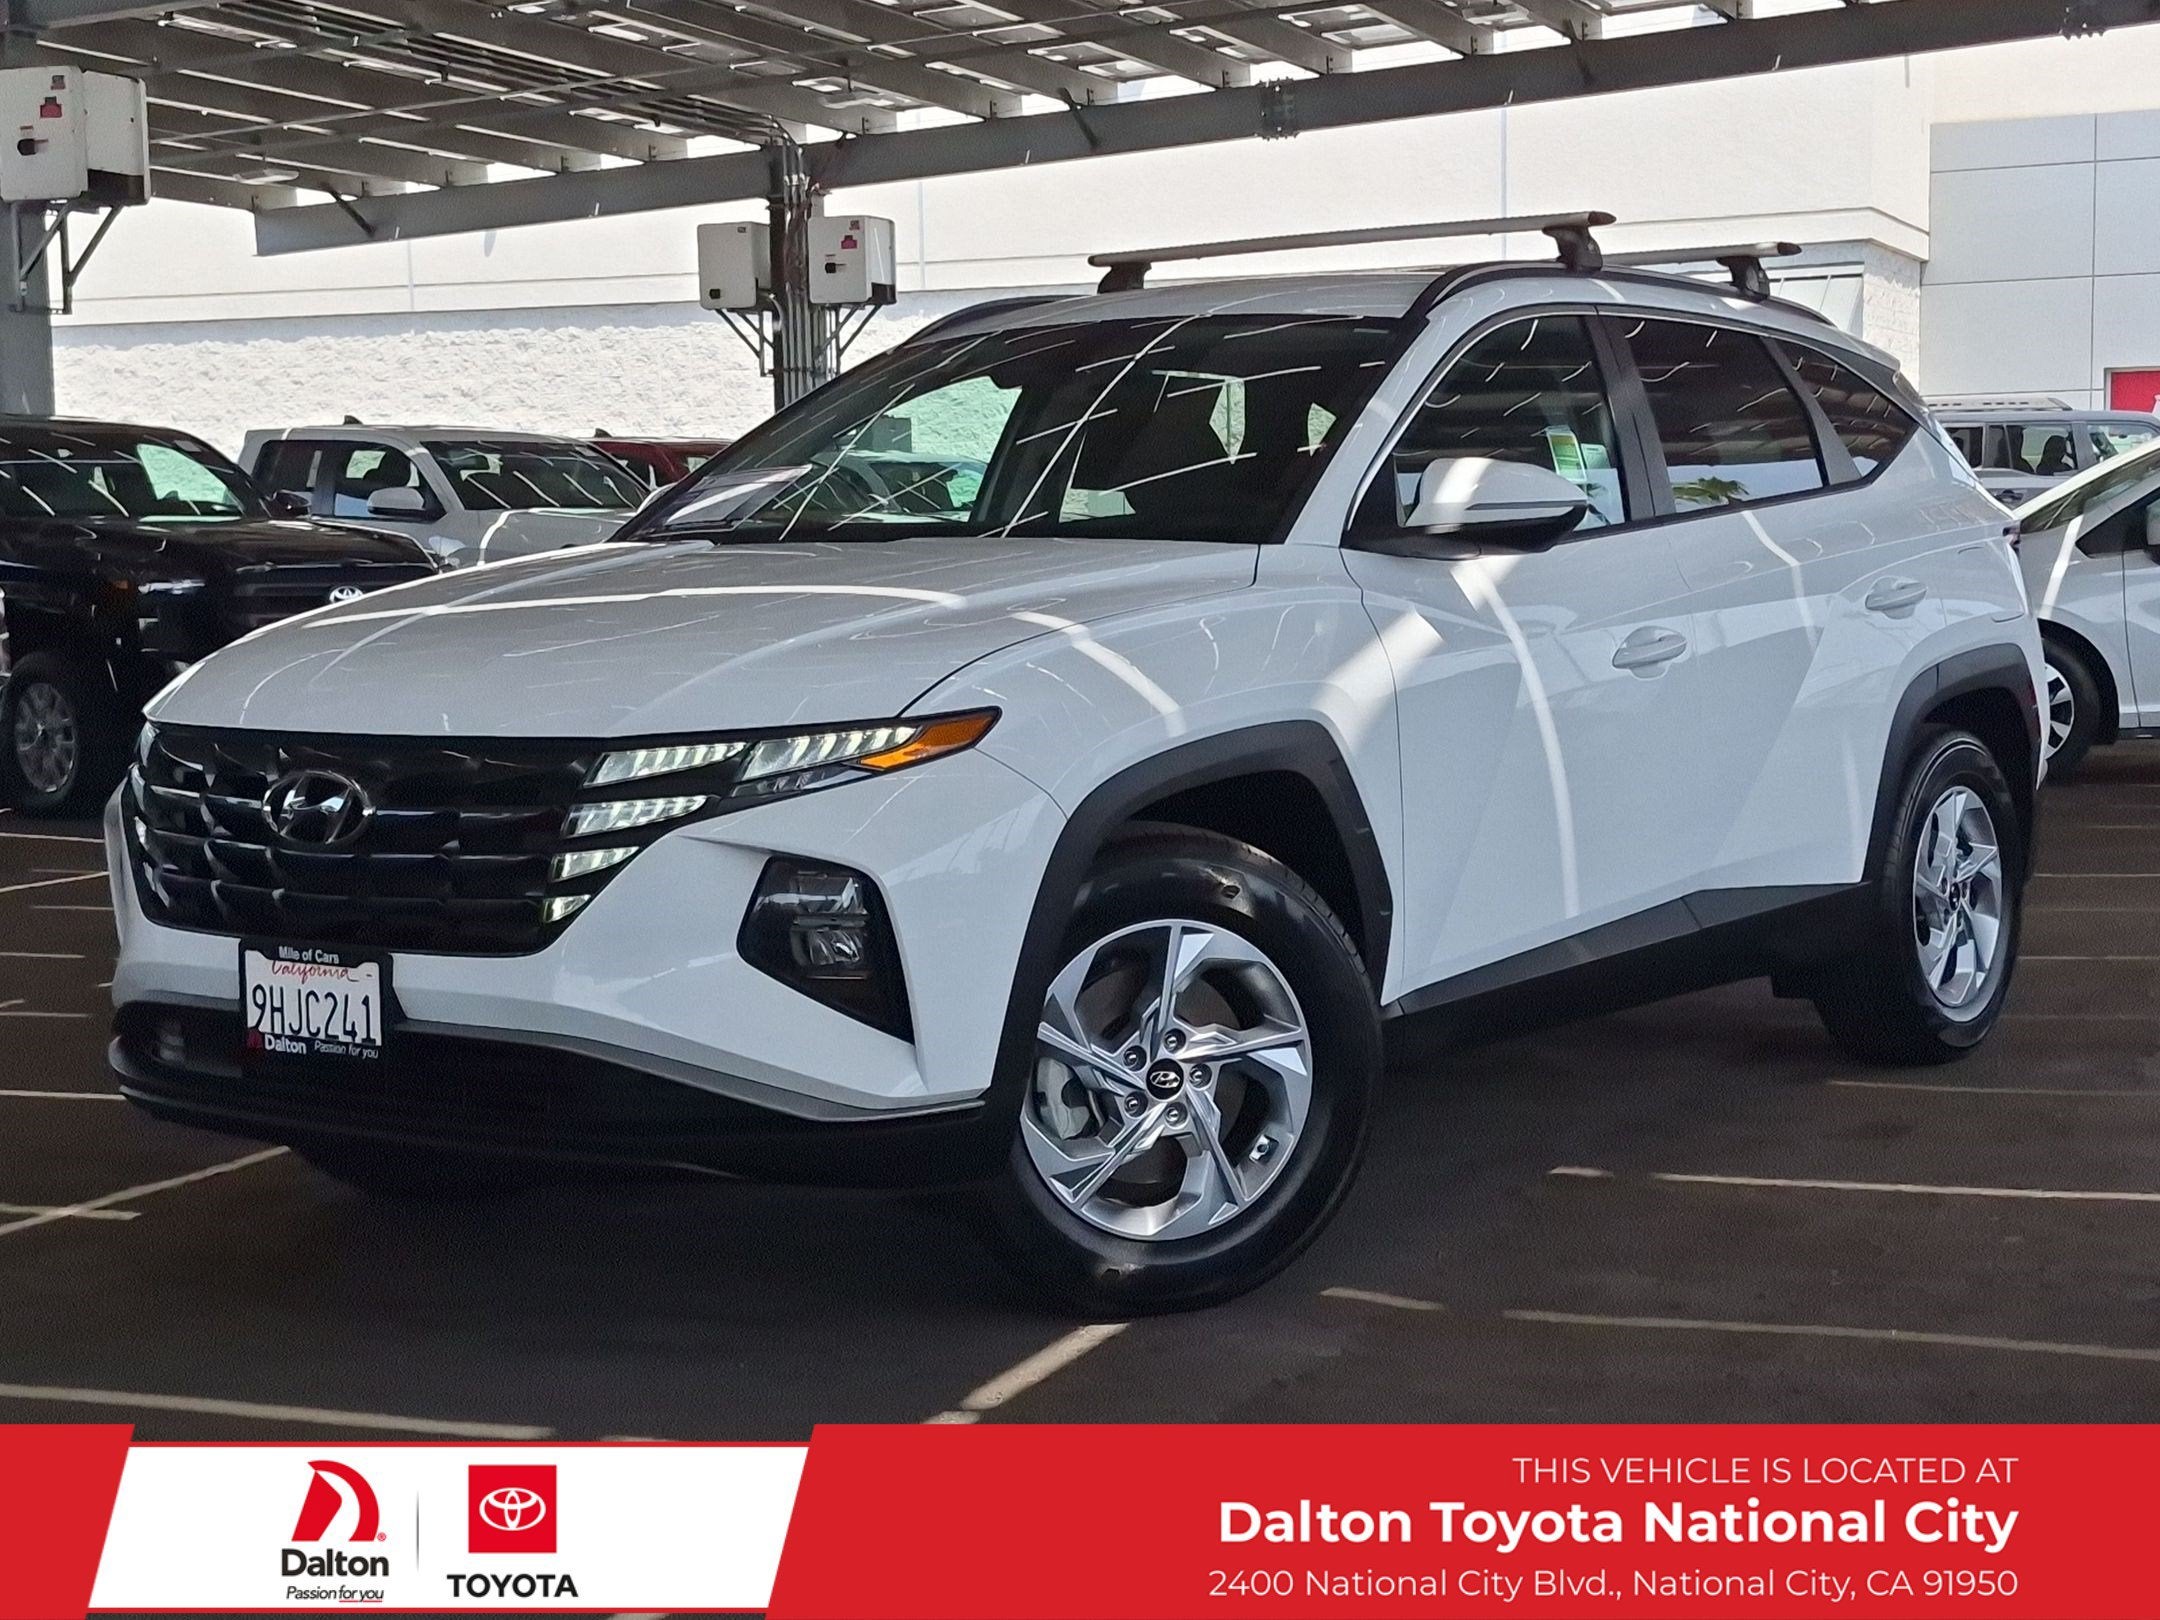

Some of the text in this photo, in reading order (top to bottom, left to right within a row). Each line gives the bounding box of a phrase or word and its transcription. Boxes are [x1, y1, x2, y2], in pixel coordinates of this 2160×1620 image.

[278, 946, 340, 964] Mile of Cars
[272, 960, 360, 984] California
[252, 983, 377, 1044] 9HJC241
[264, 1034, 379, 1059] Dalton Passion for you
